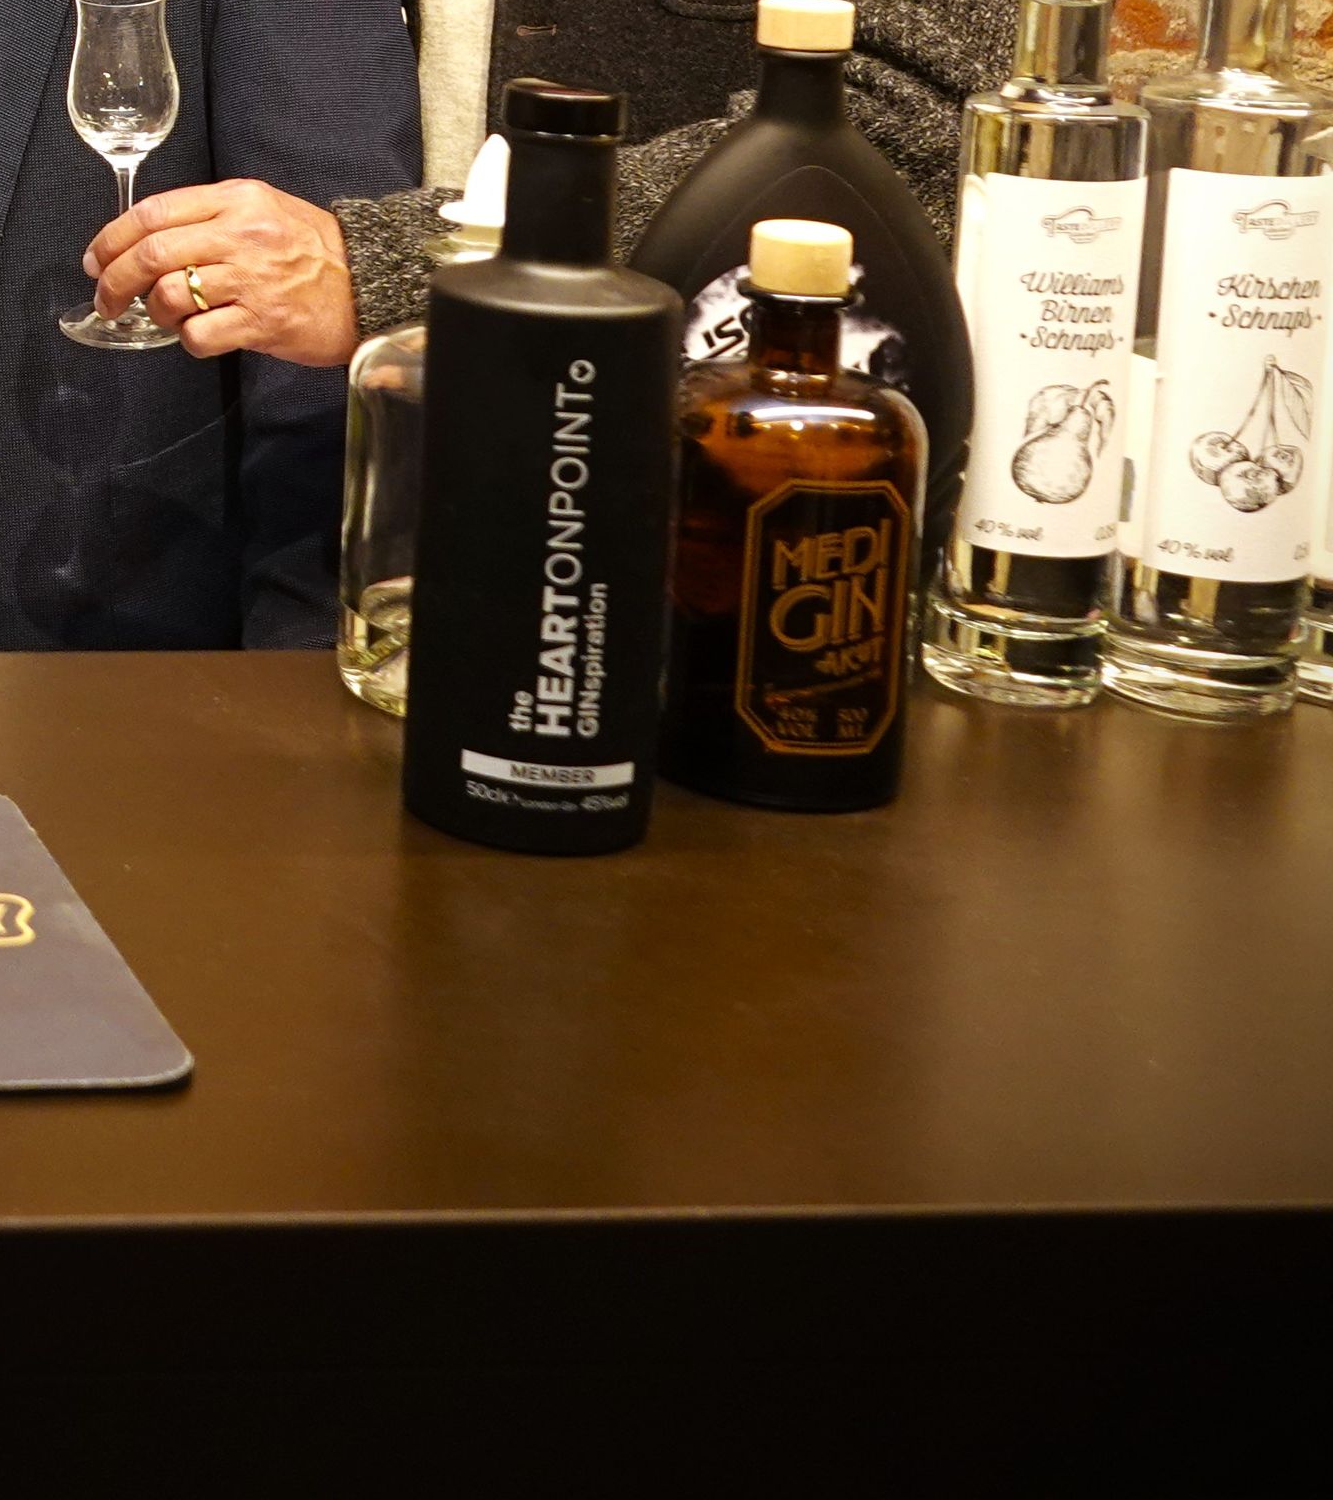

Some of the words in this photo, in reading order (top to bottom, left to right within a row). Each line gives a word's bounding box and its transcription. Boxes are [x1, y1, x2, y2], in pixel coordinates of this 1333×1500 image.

[1019, 270, 1125, 297] Williams
[1217, 273, 1322, 300] Kirschen
[1040, 299, 1113, 324] Birnen
[1221, 303, 1314, 338] Schnaps
[1030, 325, 1117, 358] Schnaps
[771, 517, 893, 591] MEDI
[768, 566, 890, 652] GIN
[576, 582, 609, 738] GINspiration
[508, 689, 534, 733] the
[509, 763, 596, 784] MEMBER
